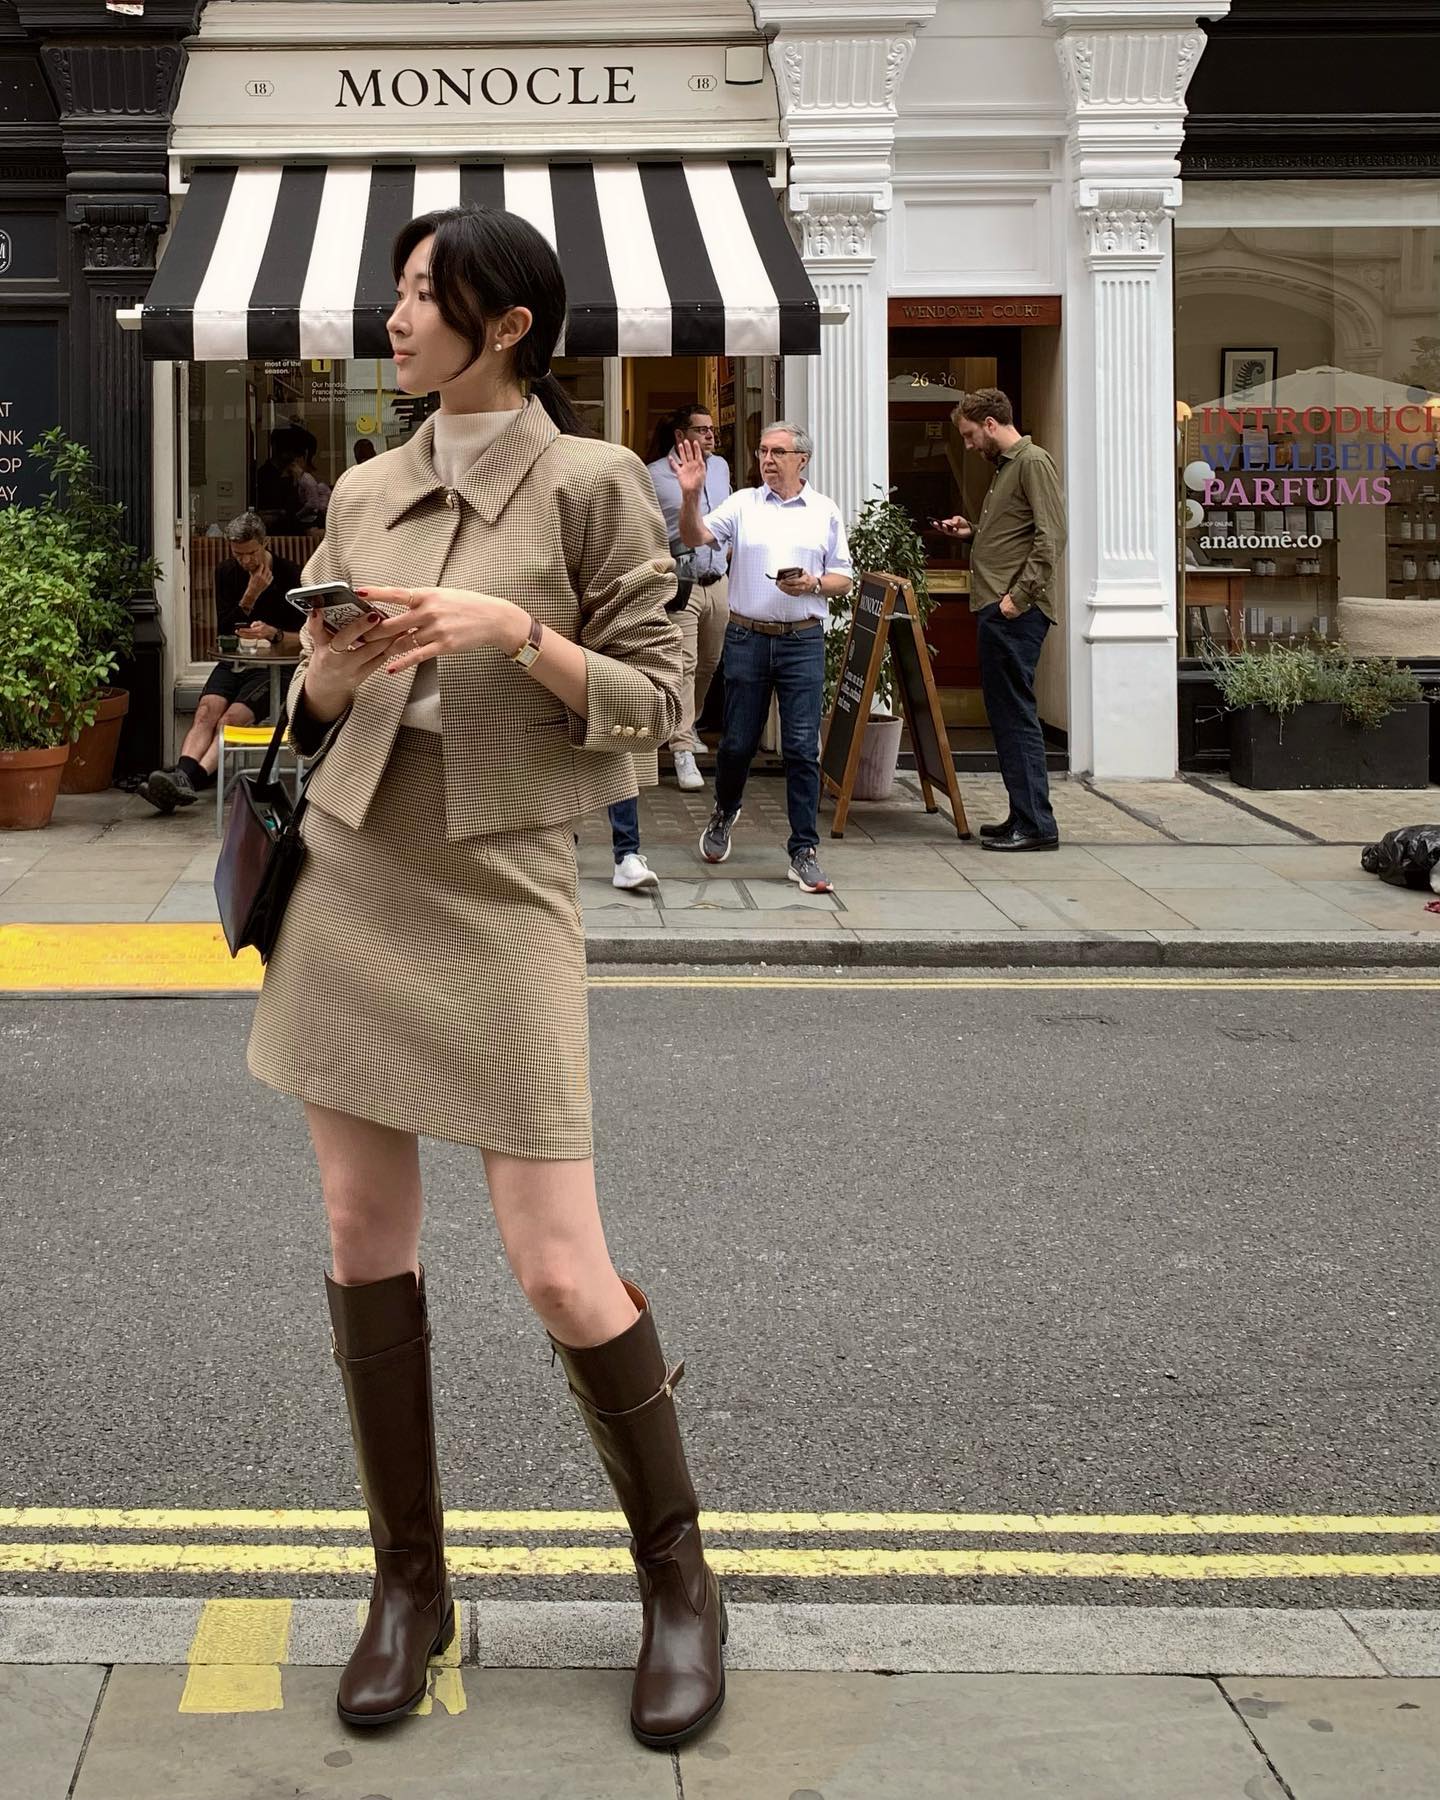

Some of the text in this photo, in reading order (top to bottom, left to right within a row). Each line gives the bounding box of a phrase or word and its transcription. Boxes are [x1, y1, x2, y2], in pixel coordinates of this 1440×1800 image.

[253, 83, 267, 95] 18
[335, 66, 636, 107] MONOCLE
[695, 77, 710, 89] 18
[903, 304, 1042, 319] WENDOVER COURT
[1201, 405, 1440, 434] INTRODUCI
[1201, 442, 1437, 472] WELLBEING
[1201, 477, 1392, 506] PARFUMS
[1200, 531, 1322, 549] anatomē.co
